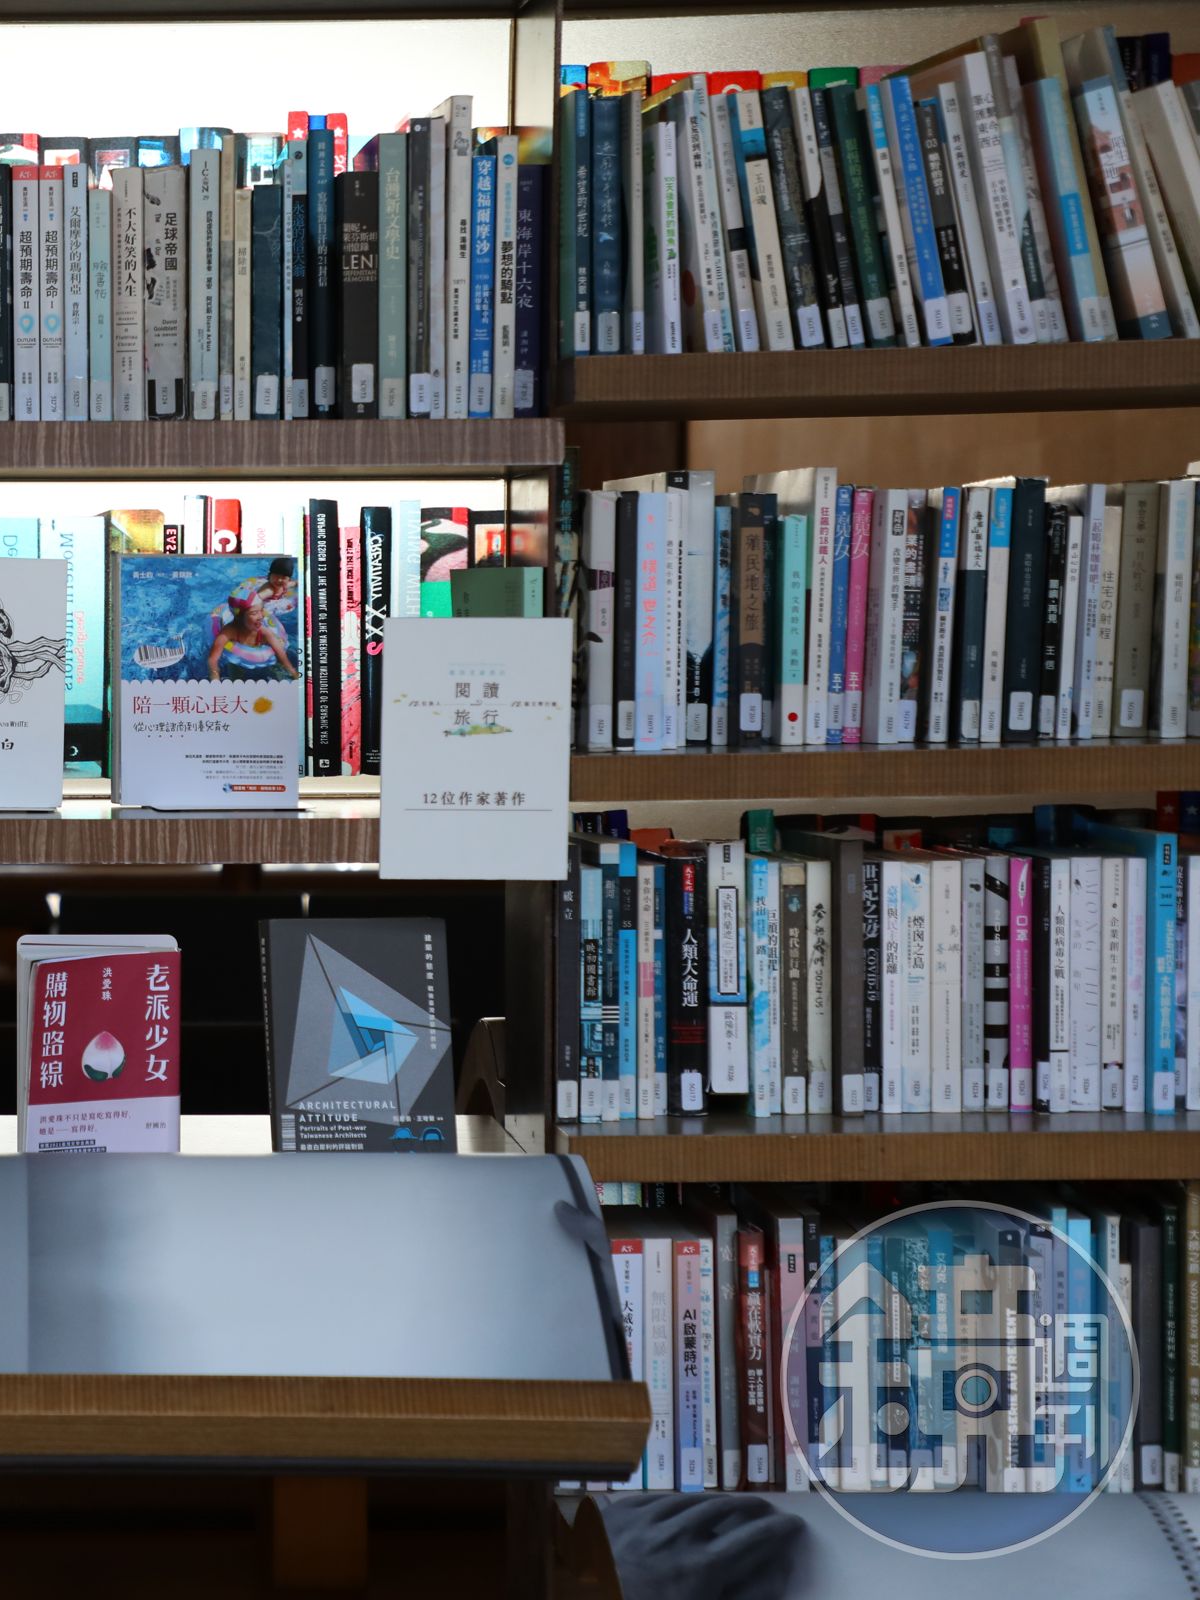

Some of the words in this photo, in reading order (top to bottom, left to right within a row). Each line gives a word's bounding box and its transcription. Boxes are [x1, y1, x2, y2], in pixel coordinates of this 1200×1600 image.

[385, 166, 401, 260] 台灣新文學史
[476, 158, 491, 255] 穿越福爾摩沙
[19, 231, 33, 298] 超預期壽命
[45, 231, 58, 298] 超預期壽命
[124, 207, 137, 297] 不大好笑的人生
[164, 212, 178, 272] 足球帝國
[516, 208, 534, 309] 東海岸十六夜
[852, 510, 870, 560] 魔女
[133, 695, 249, 715] 陪一顆心長大
[453, 709, 499, 727] 旅行
[455, 682, 500, 699] 閱讀
[422, 791, 527, 807] 12位作家著作
[101, 967, 113, 1001] 洪愛珠
[681, 929, 699, 1007] 人類大命運
[40, 971, 68, 1089] 購物路線
[145, 964, 171, 1082] 老派少女
[298, 1101, 397, 1110] ARCHITECTURAL
[299, 1113, 358, 1122] ATTITUDE
